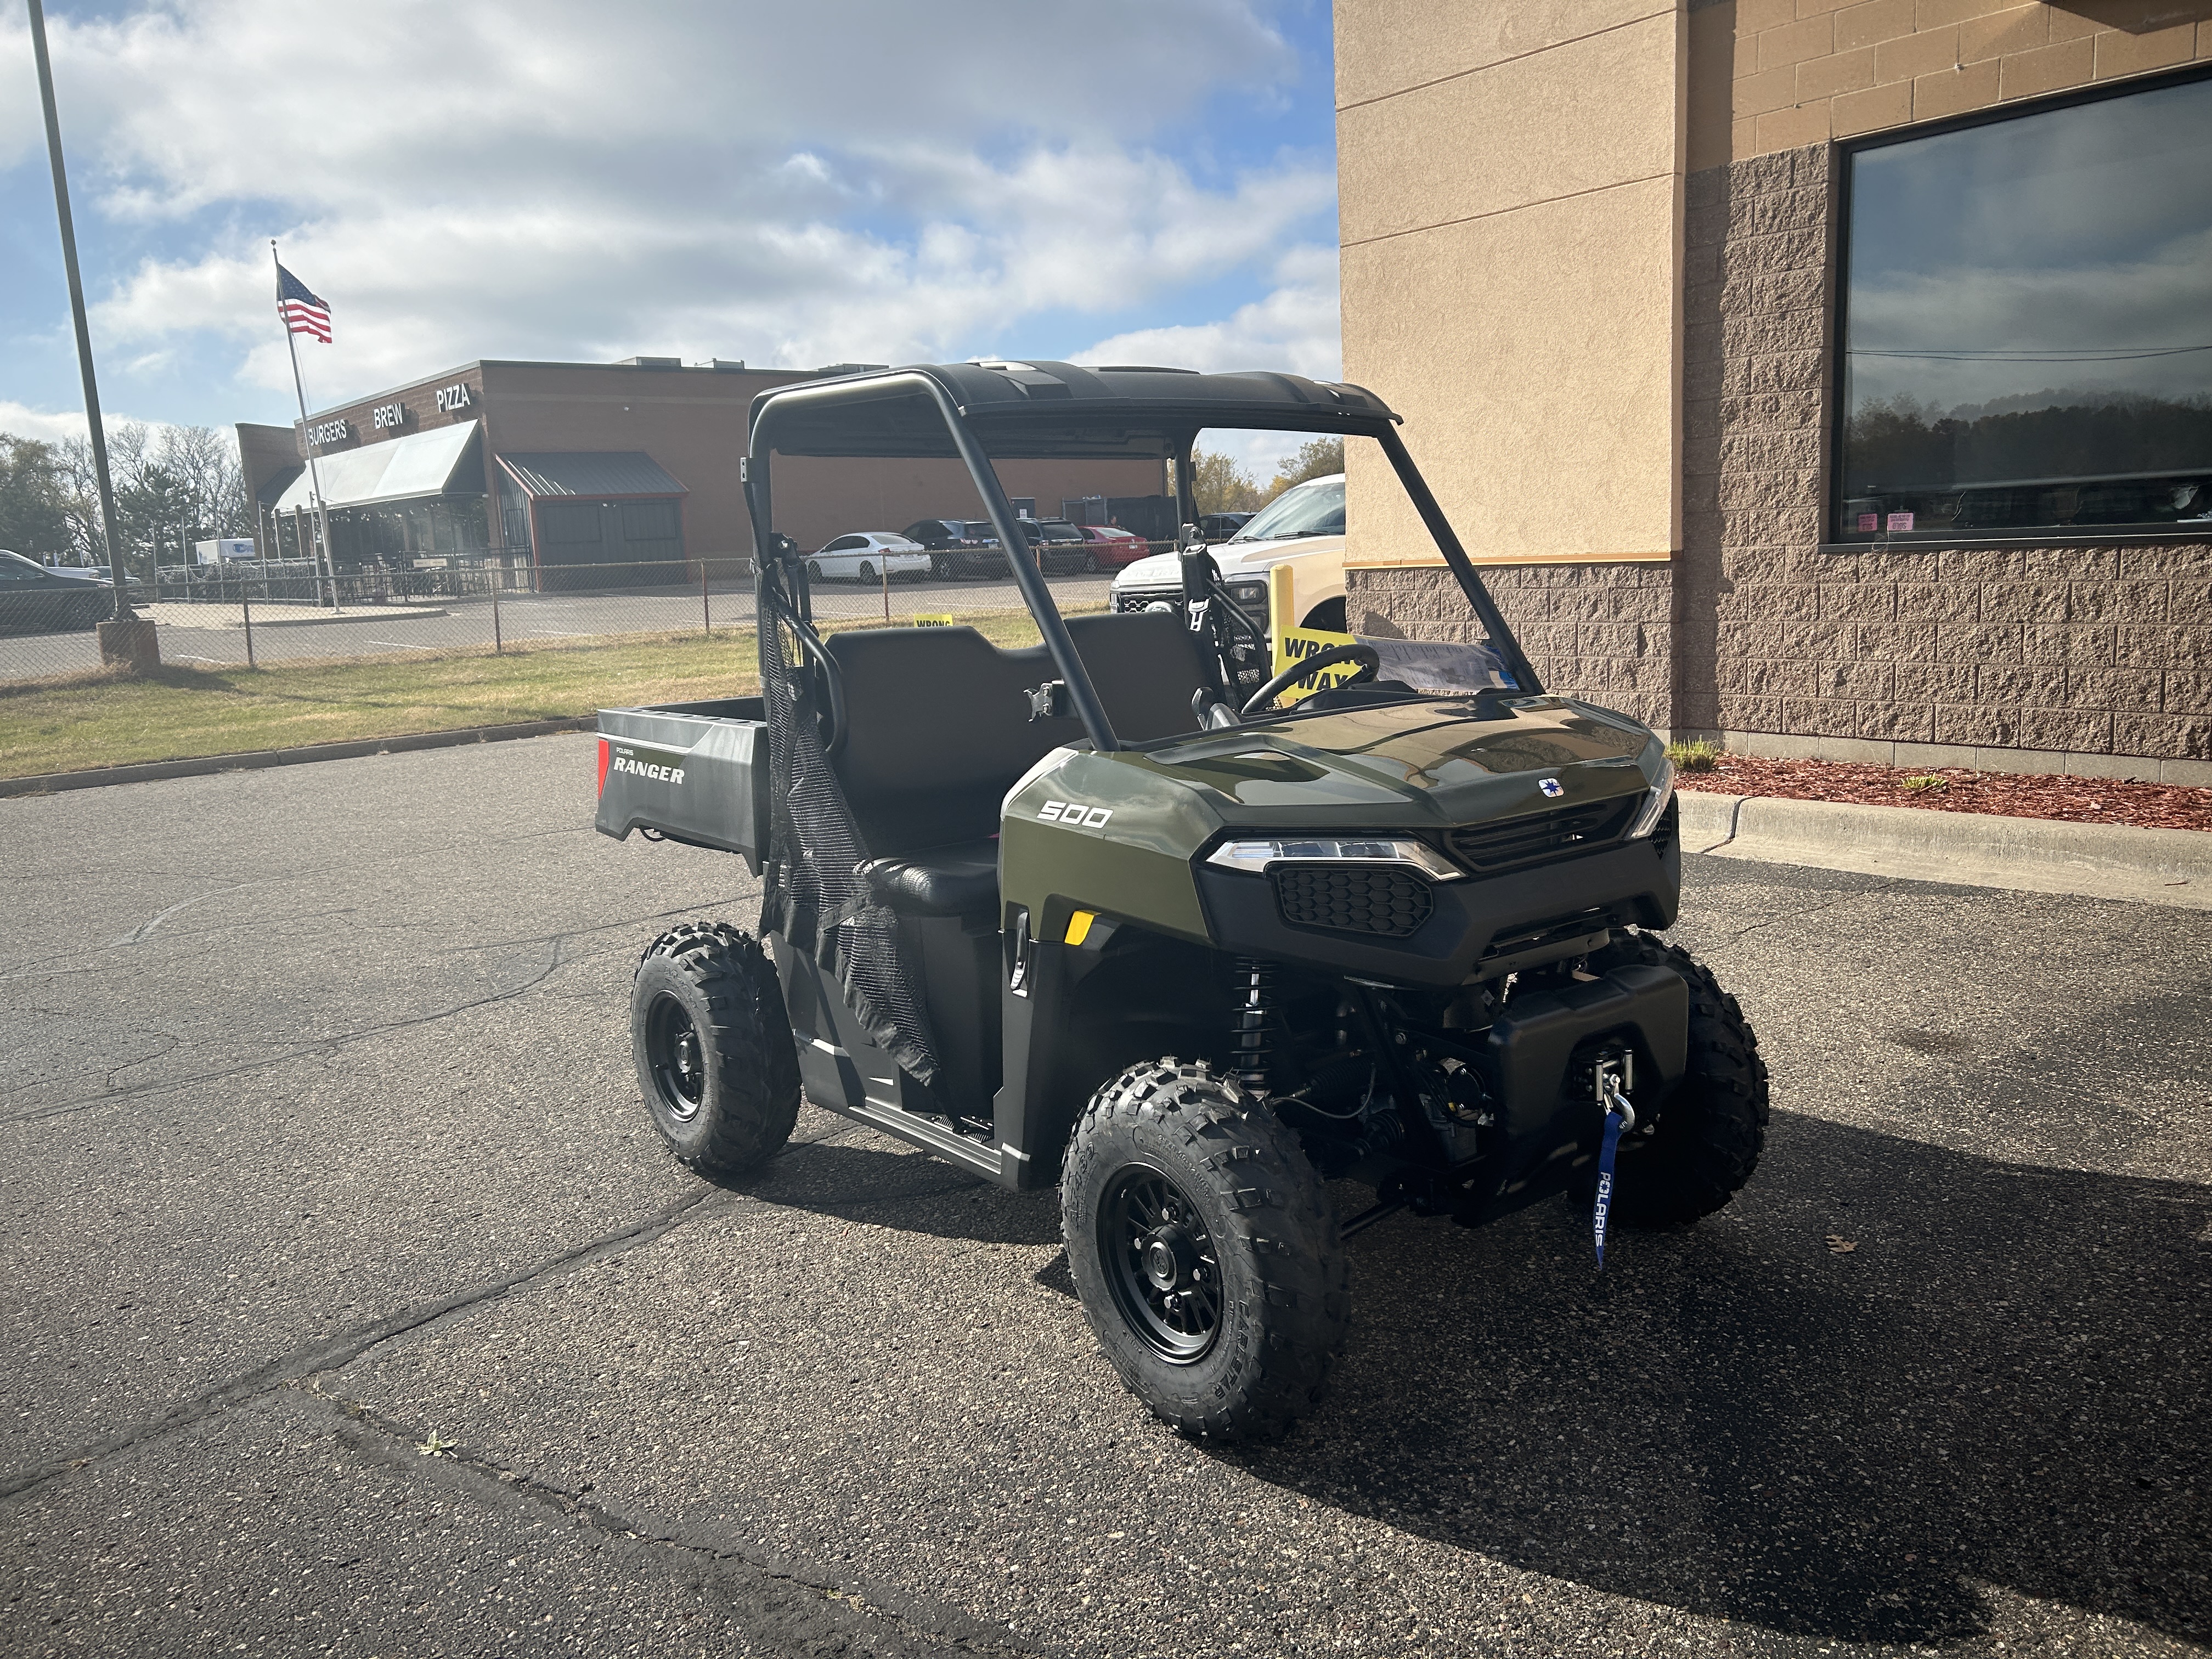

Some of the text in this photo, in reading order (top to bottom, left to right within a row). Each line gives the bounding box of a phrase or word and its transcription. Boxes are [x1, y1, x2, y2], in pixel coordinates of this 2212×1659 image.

[308, 383, 470, 446] BURGERS BREW PIZZA
[616, 747, 634, 756] POLARIS
[613, 757, 685, 785] RANGER
[1036, 800, 1114, 829] 500
[1595, 1171, 1611, 1247] POLARIS
